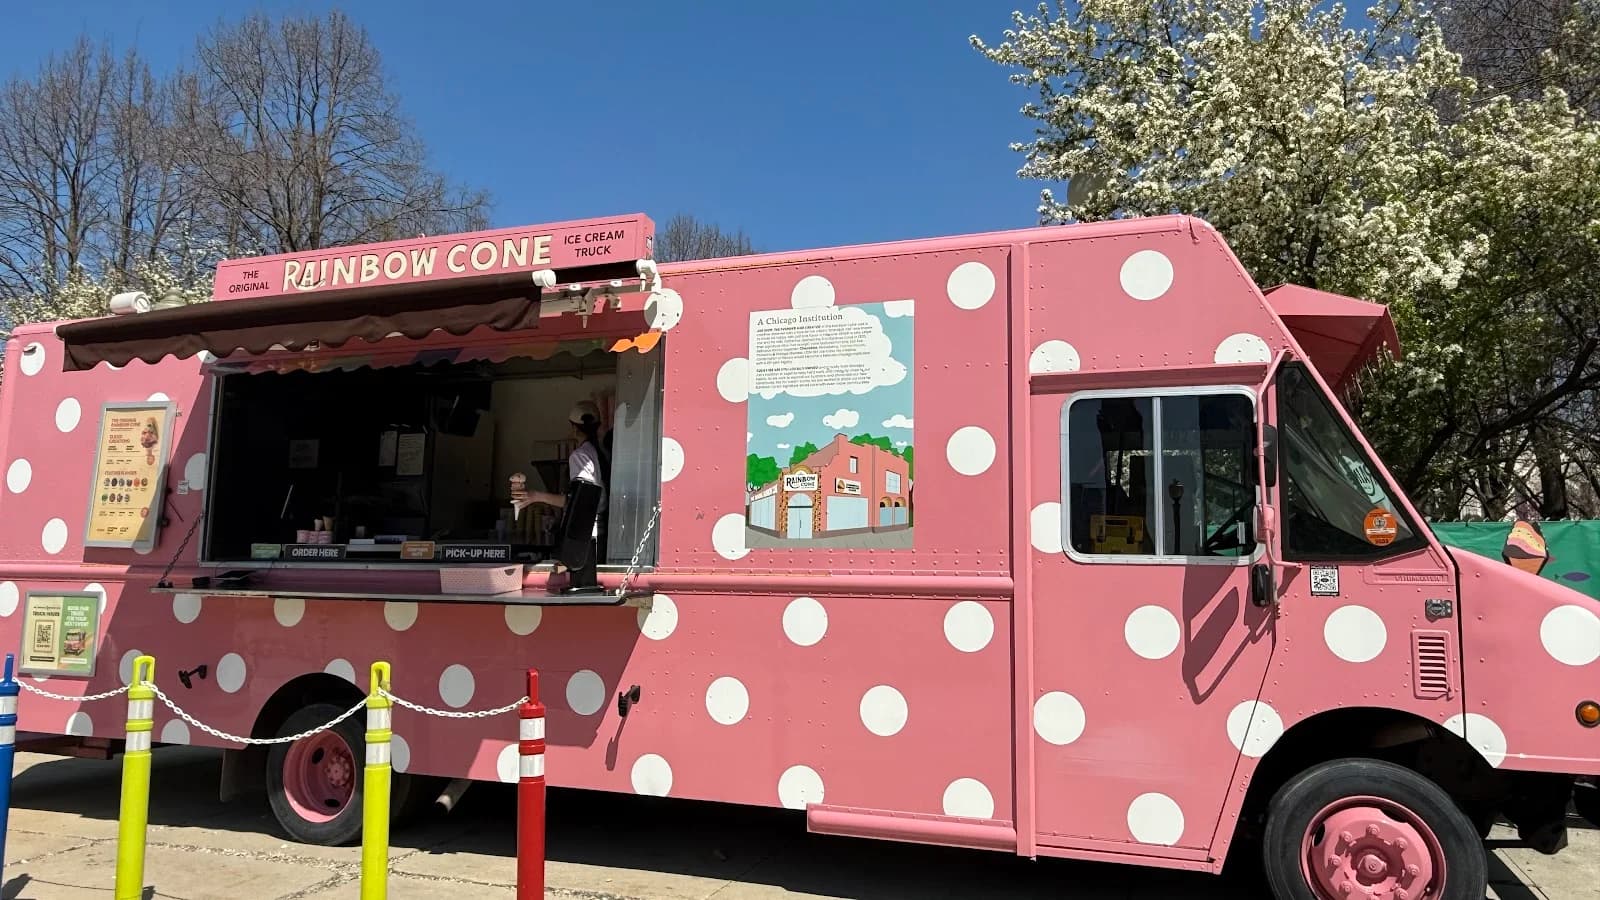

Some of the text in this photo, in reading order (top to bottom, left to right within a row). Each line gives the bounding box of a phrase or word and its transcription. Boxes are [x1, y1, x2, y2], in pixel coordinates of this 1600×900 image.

[564, 230, 624, 245] ICE CREAM
[574, 245, 612, 258] TRUCK
[282, 235, 553, 293] RAINBOW CONE
[242, 270, 260, 280] THE
[228, 281, 270, 293] ORIGINAL
[766, 316, 797, 326] Chicago
[799, 313, 843, 323] Institution
[786, 476, 815, 489] RAINBOW
[292, 548, 338, 557] ORDER HERE
[445, 548, 506, 558] PICK-UP HERE
